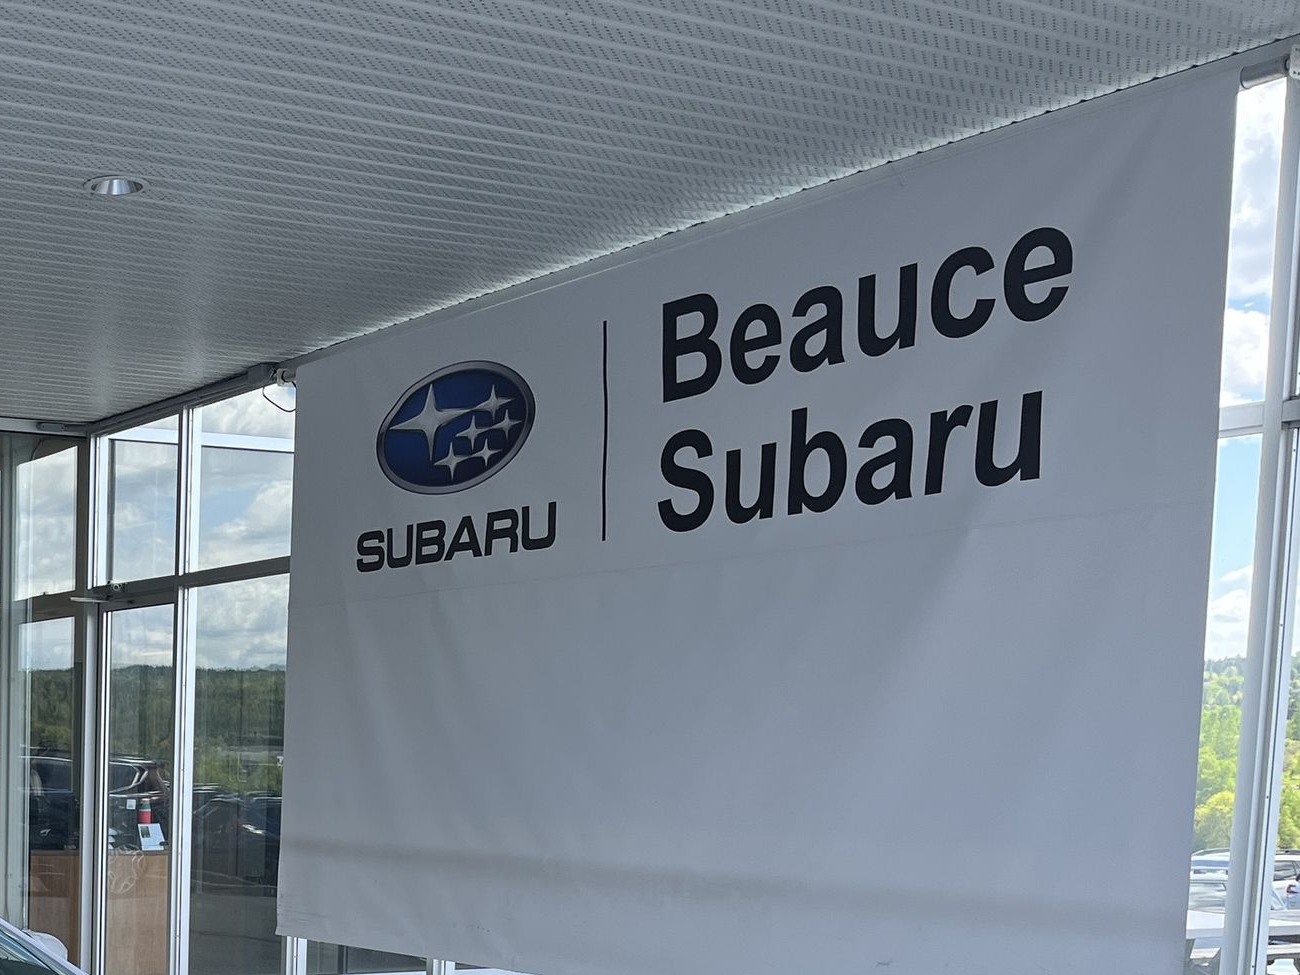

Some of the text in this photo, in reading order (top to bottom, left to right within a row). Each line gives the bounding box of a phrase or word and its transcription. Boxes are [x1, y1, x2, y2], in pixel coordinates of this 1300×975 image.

[663, 227, 1073, 403] Beauce
[658, 390, 1043, 532] Subaru
[357, 501, 557, 573] SUBARU
